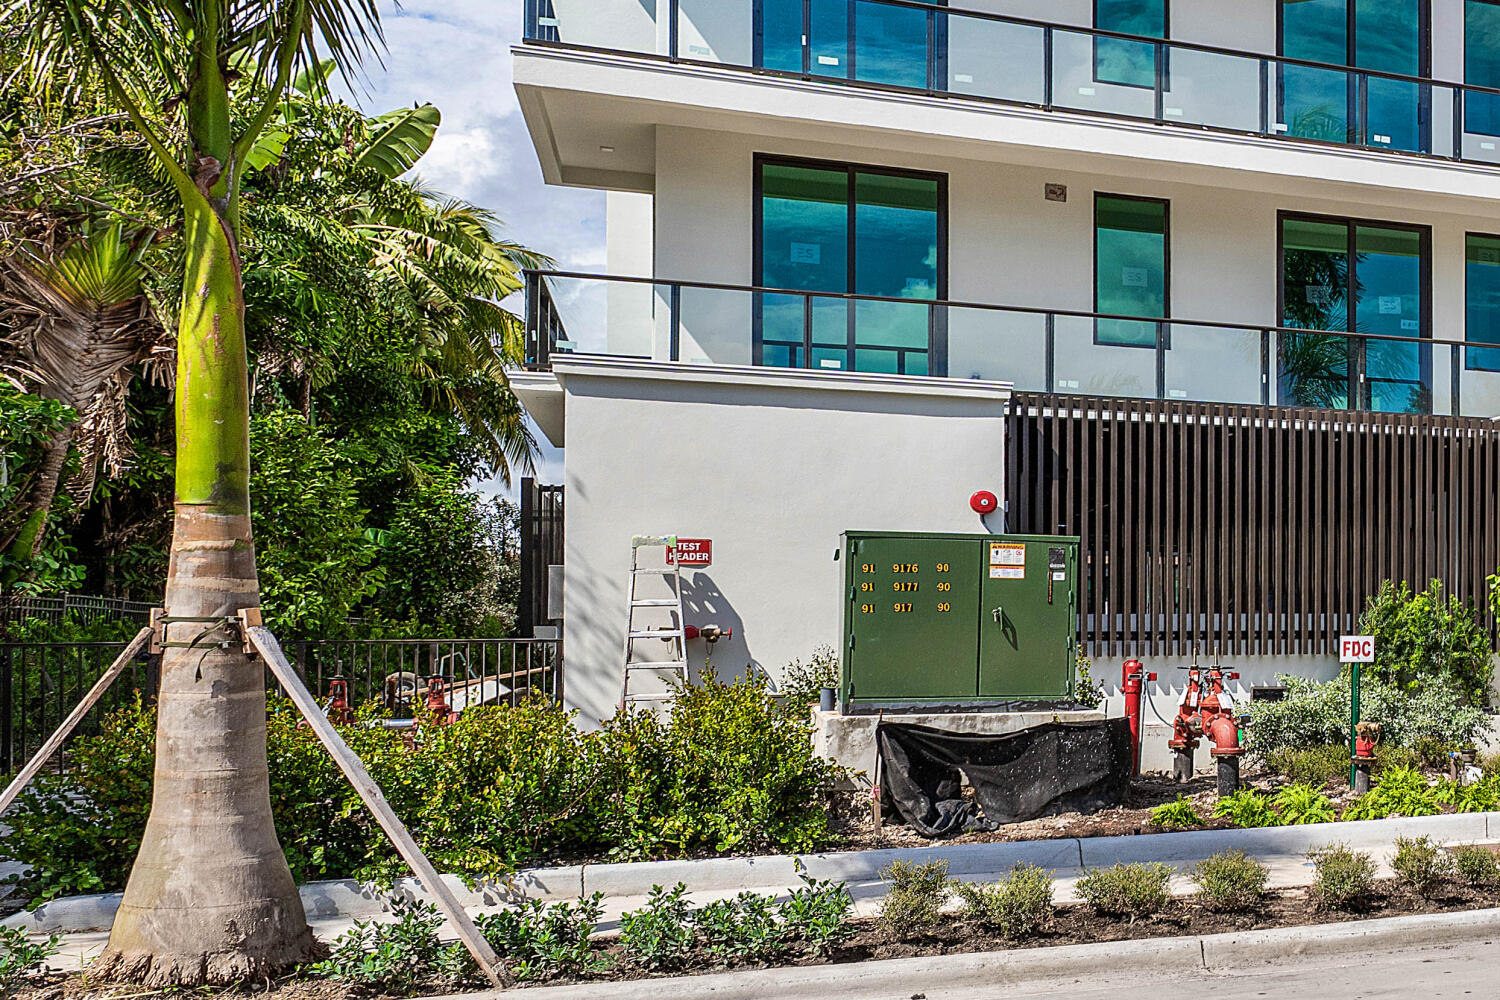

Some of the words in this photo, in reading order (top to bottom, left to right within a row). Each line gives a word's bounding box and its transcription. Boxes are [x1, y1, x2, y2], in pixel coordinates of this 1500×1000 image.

[676, 542, 701, 551] TEST
[861, 563, 875, 573] 91
[892, 563, 919, 573] 9176
[936, 562, 950, 572] 90
[861, 582, 875, 592] 91
[893, 582, 919, 592] 9177
[937, 582, 951, 592] 90
[861, 604, 875, 613] 91
[893, 603, 913, 612] 917
[937, 602, 951, 612] 90
[1343, 641, 1371, 657] FDC
